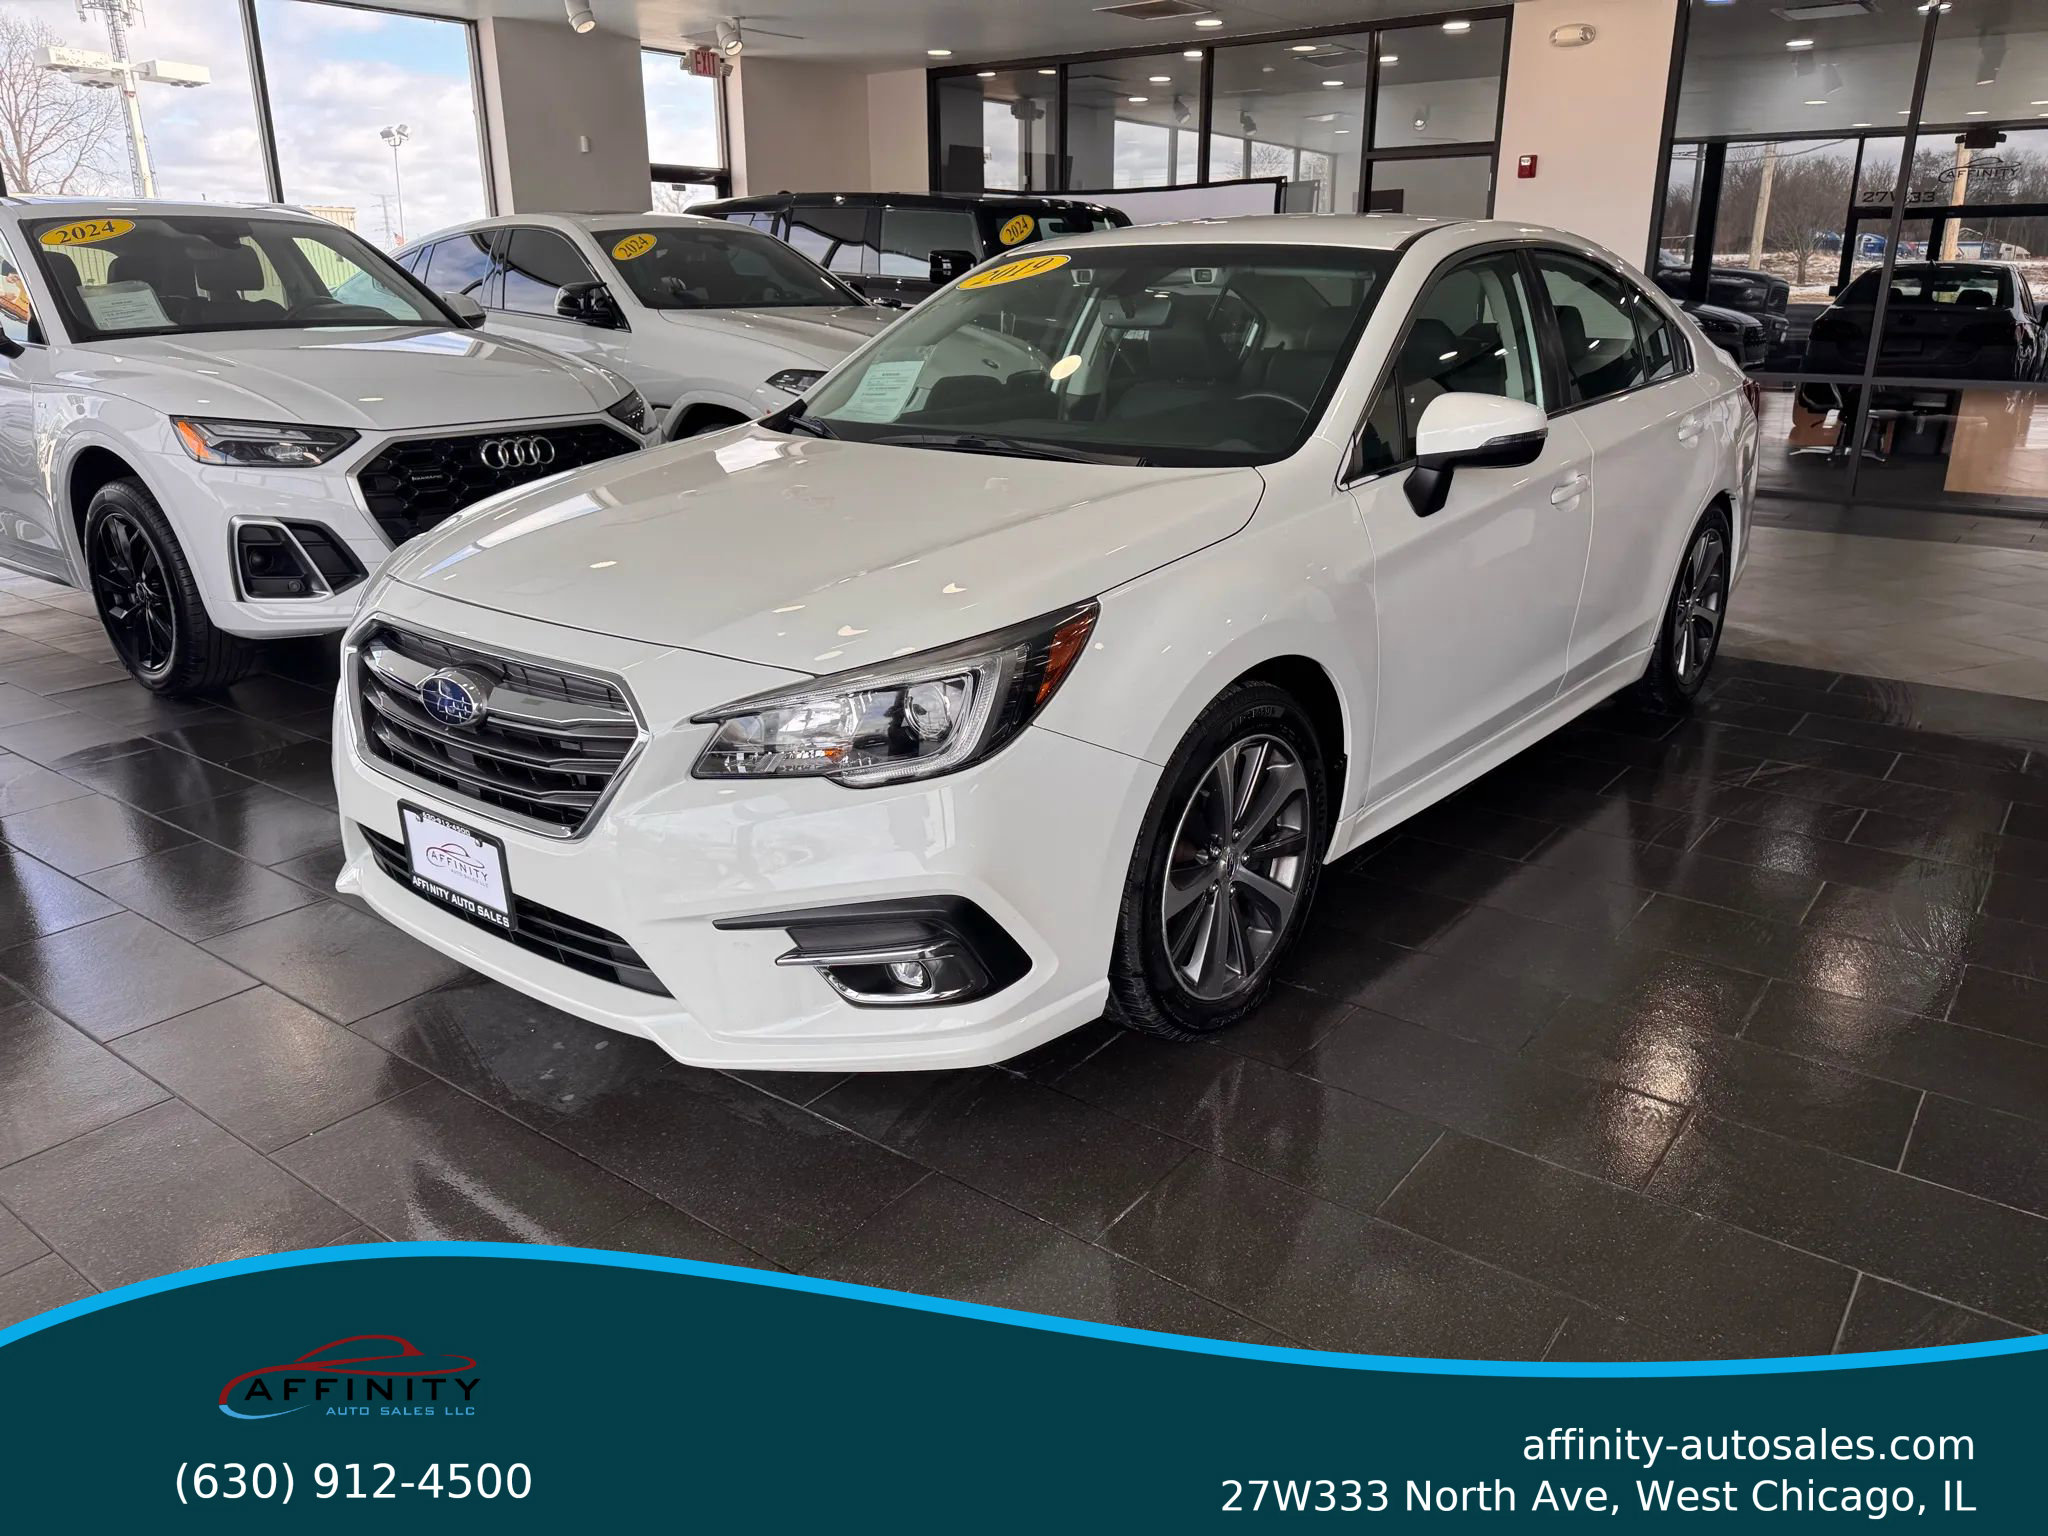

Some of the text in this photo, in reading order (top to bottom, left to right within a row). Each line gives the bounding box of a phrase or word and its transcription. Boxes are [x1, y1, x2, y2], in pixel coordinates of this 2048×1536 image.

[695, 51, 717, 76] EXIT
[1945, 167, 2018, 179] AFFINITY
[55, 220, 116, 244] 2024
[1005, 216, 1029, 242] 2024
[618, 236, 649, 258] 2024
[968, 257, 1055, 287] 2019
[431, 850, 488, 881] AFFINITY
[412, 874, 510, 927] AFFINITY AUTO SALES
